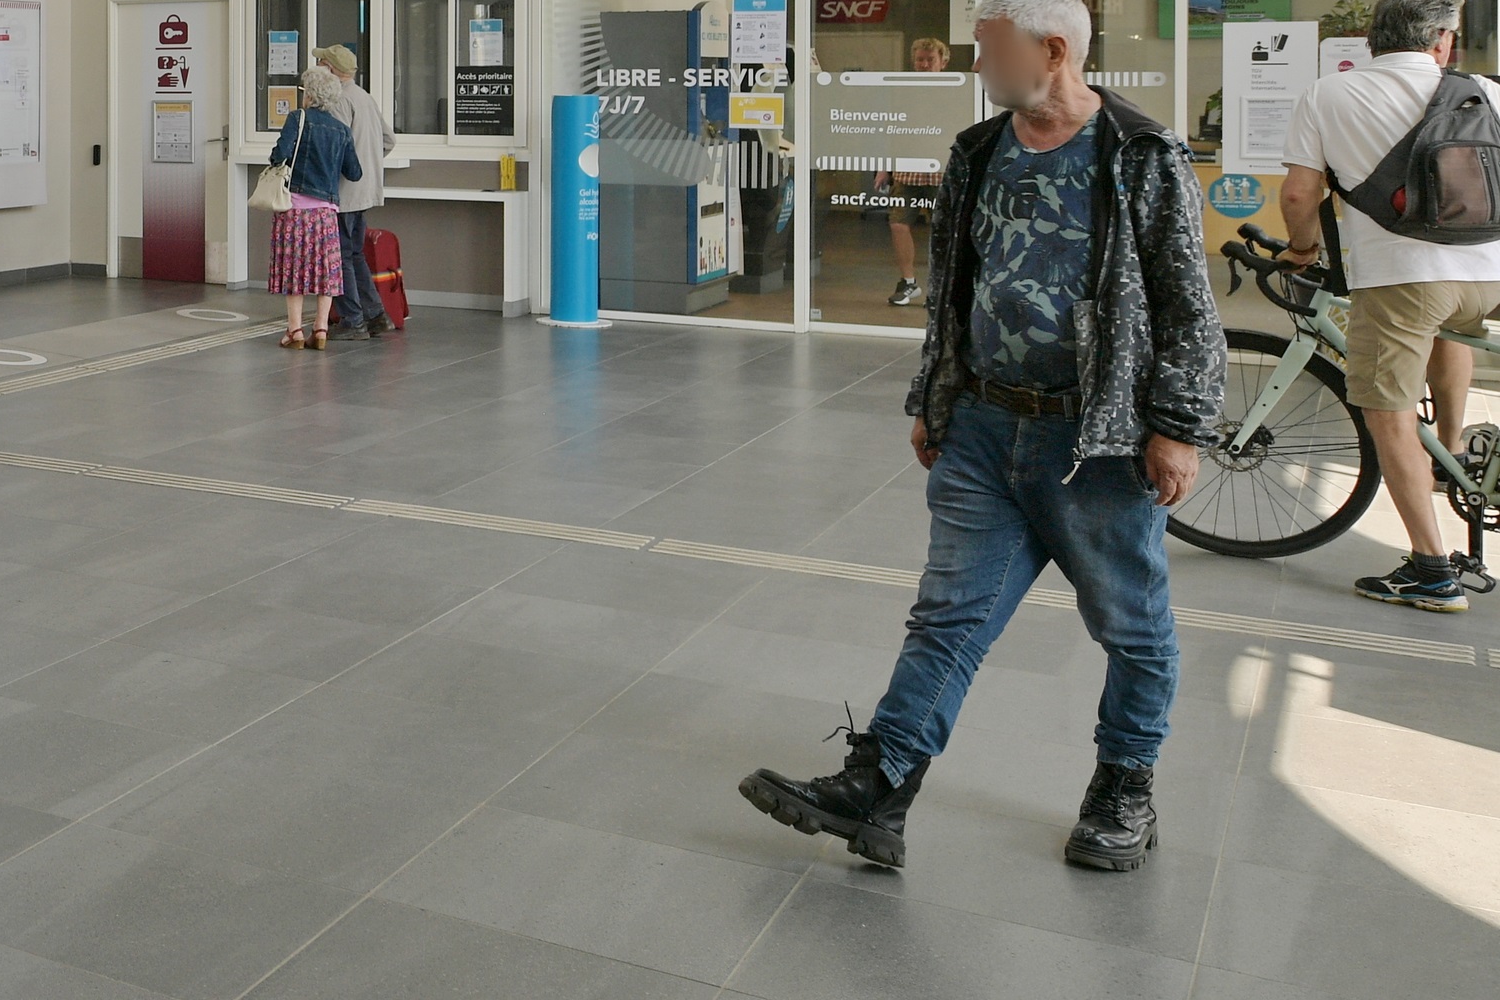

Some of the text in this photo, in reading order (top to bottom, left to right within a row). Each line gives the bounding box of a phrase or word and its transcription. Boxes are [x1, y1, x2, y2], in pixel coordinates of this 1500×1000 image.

[820, 0, 886, 18] SNCF
[456, 72, 512, 81] Accès prioritaire
[596, 68, 661, 87] LIBRE
[683, 68, 788, 87] SERVICE
[598, 96, 646, 114] 7J/7
[830, 108, 907, 122] Bienvenue
[830, 124, 942, 135] Welcome Bienvenido
[830, 192, 936, 210] sncf.com 24h/
